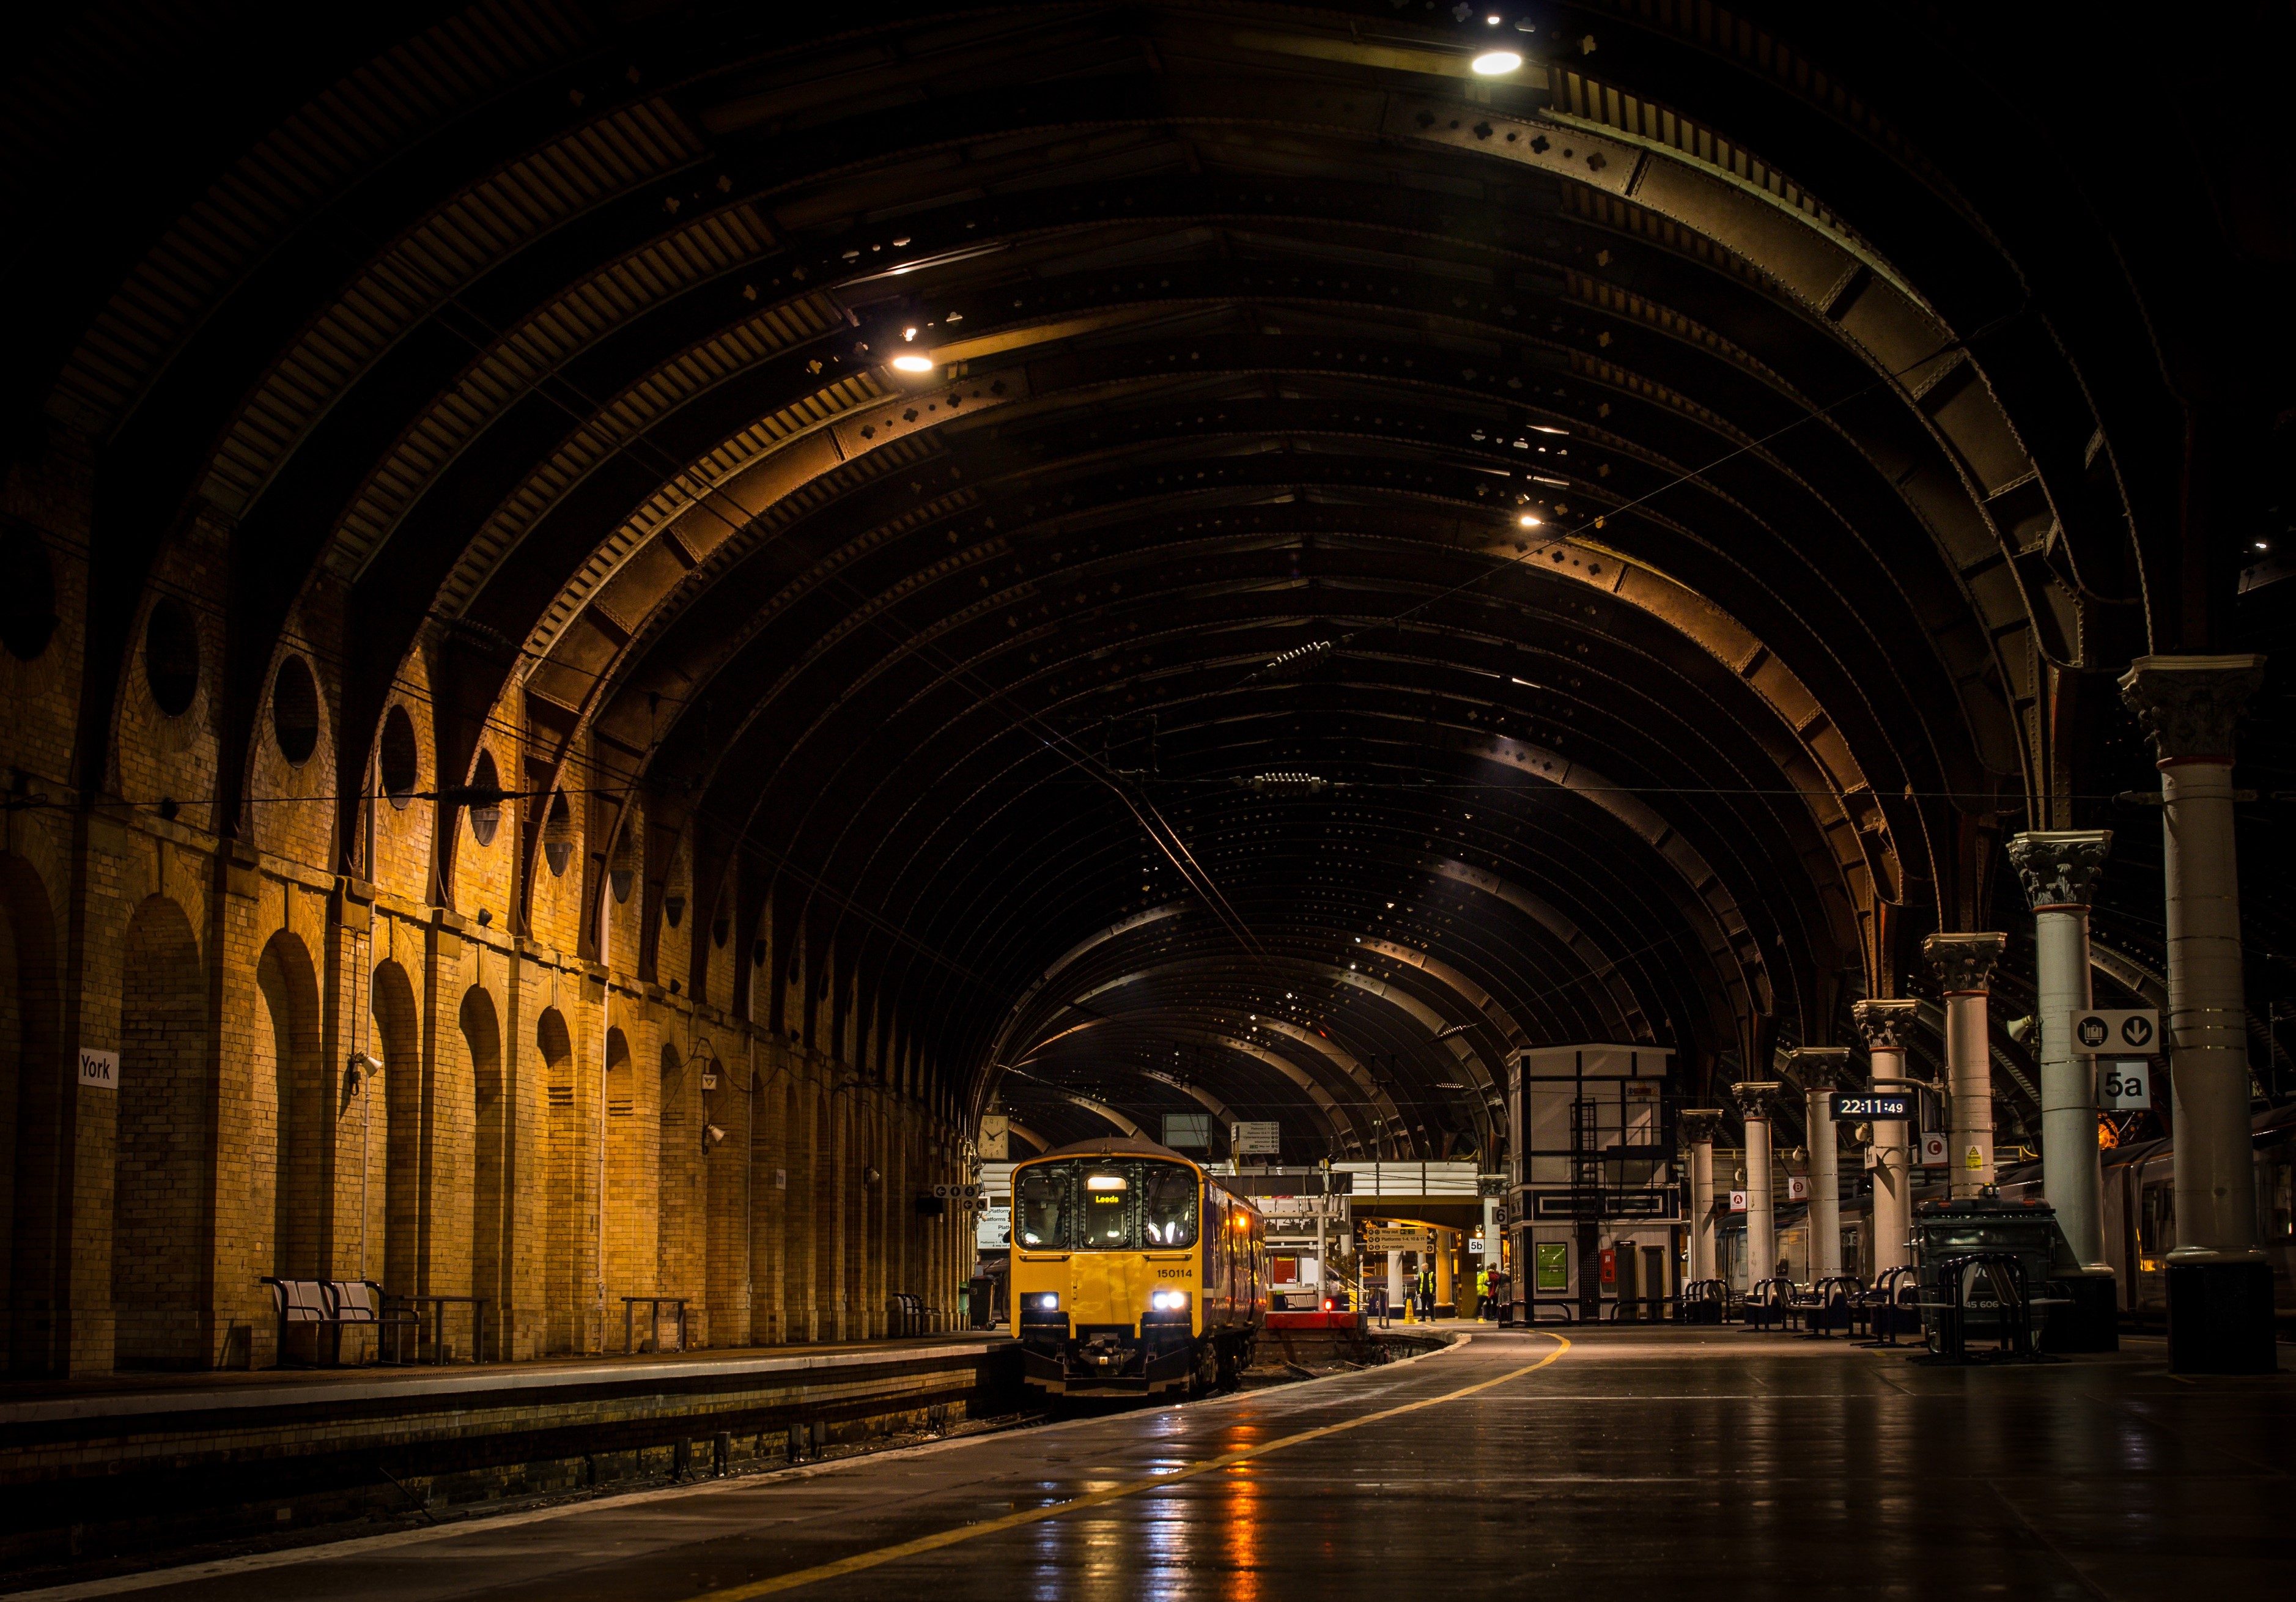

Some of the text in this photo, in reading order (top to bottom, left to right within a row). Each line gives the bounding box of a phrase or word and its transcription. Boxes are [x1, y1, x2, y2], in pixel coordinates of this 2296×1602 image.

[81, 1055, 110, 1080] York
[2105, 1072, 2143, 1098] 5a
[1841, 1099, 1903, 1113] 22:11:49
[1930, 1142, 1938, 1153] C
[1496, 1209, 1505, 1222] 6
